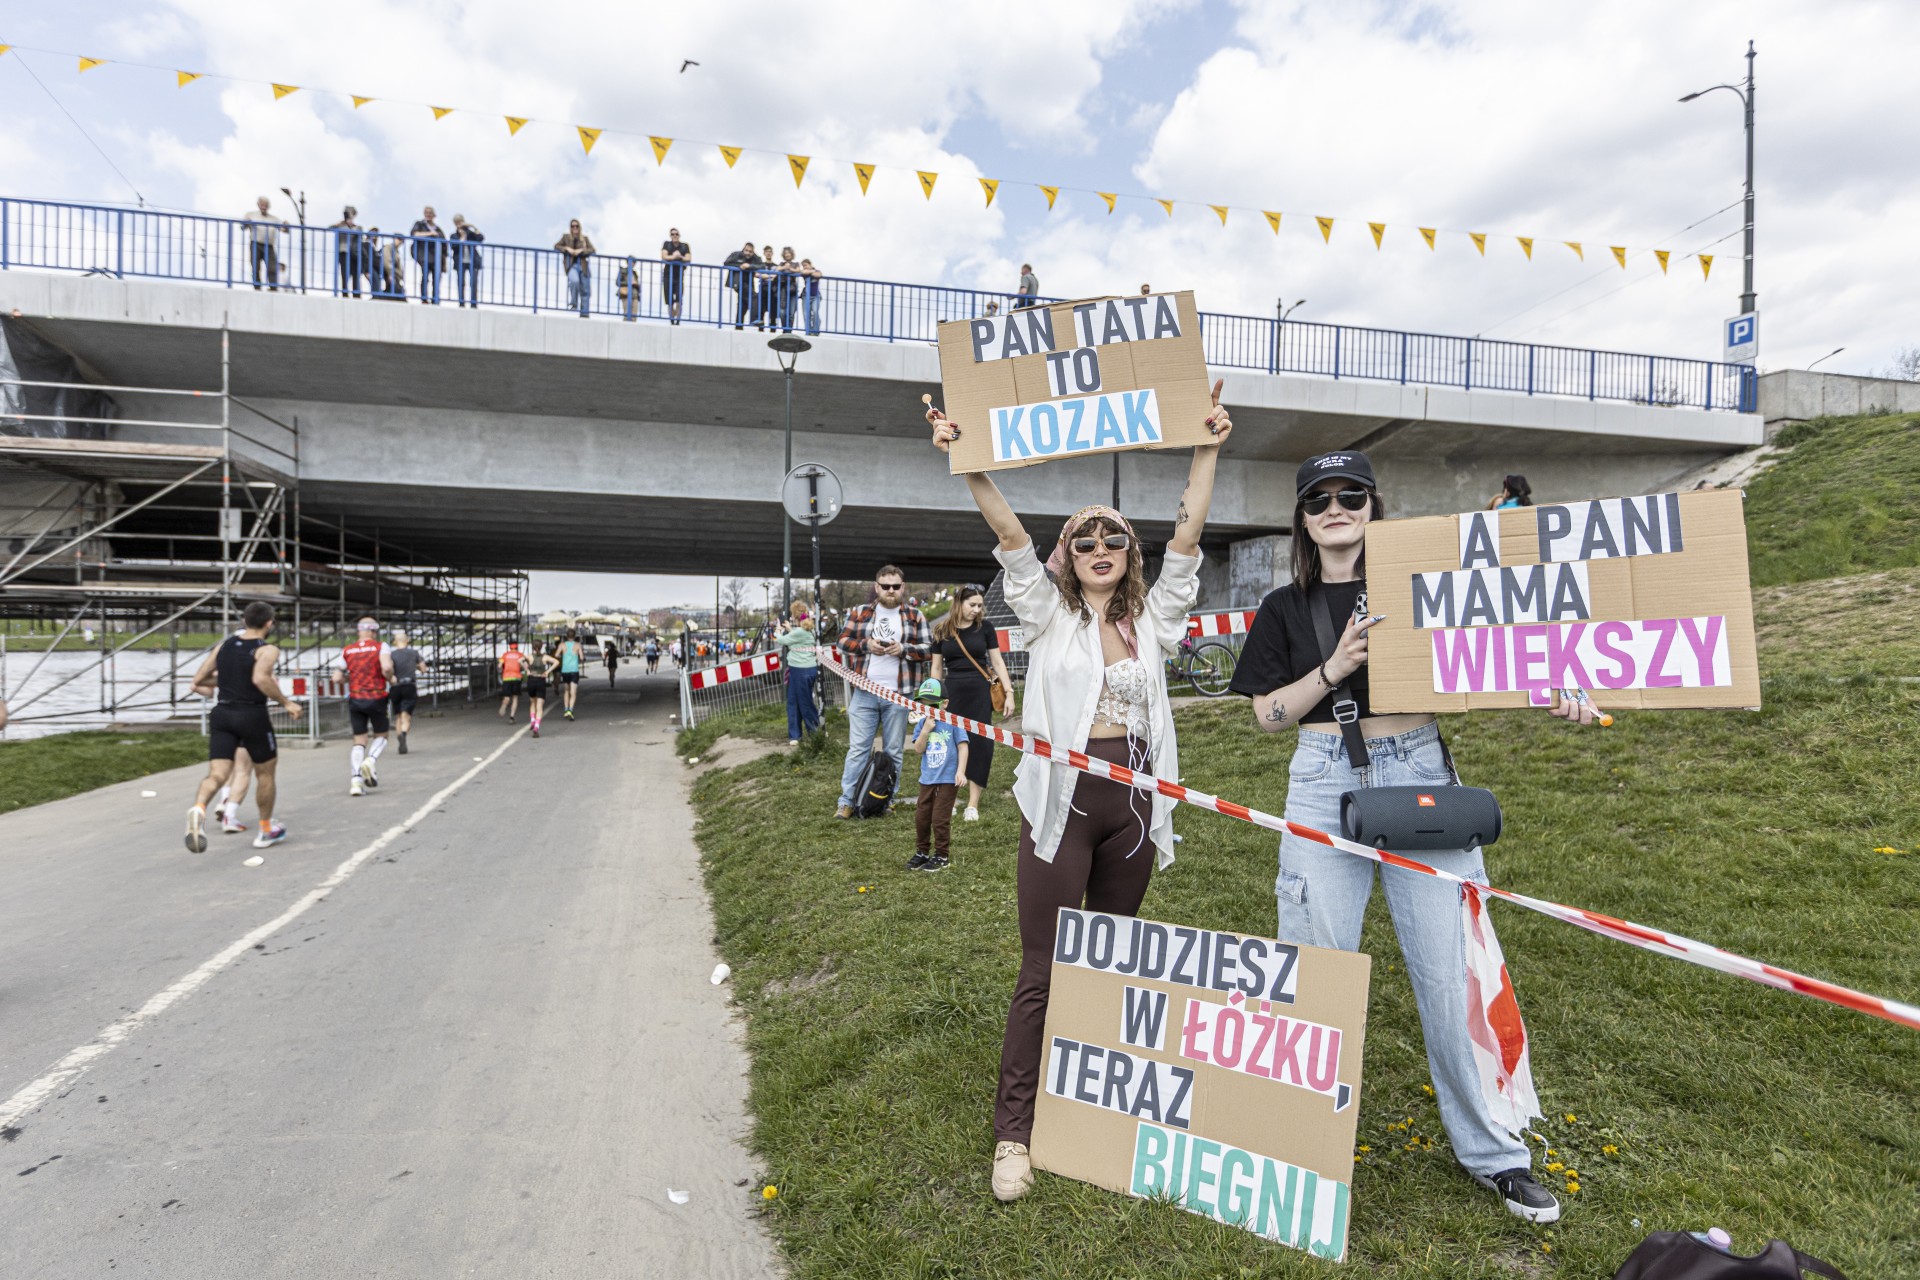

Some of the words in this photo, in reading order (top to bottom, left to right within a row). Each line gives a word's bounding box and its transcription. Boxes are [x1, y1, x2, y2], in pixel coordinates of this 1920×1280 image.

[971, 308, 1055, 362] PAN
[1073, 296, 1181, 347] TATA
[1733, 321, 1749, 344] P
[1047, 347, 1101, 396] TO
[998, 390, 1159, 459] KOZAK
[1462, 512, 1500, 569] A
[1537, 492, 1683, 562] PANI
[1412, 562, 1590, 628] MAMA
[1432, 615, 1724, 705] WIĘKSZY
[1055, 910, 1299, 1004] DOJDZIESZ
[1053, 1037, 1194, 1129] TERAZ
[1126, 987, 1168, 1049] W
[1183, 991, 1351, 1110] ŁÓŻKU,
[1132, 1126, 1349, 1261] BIEGNIJ
